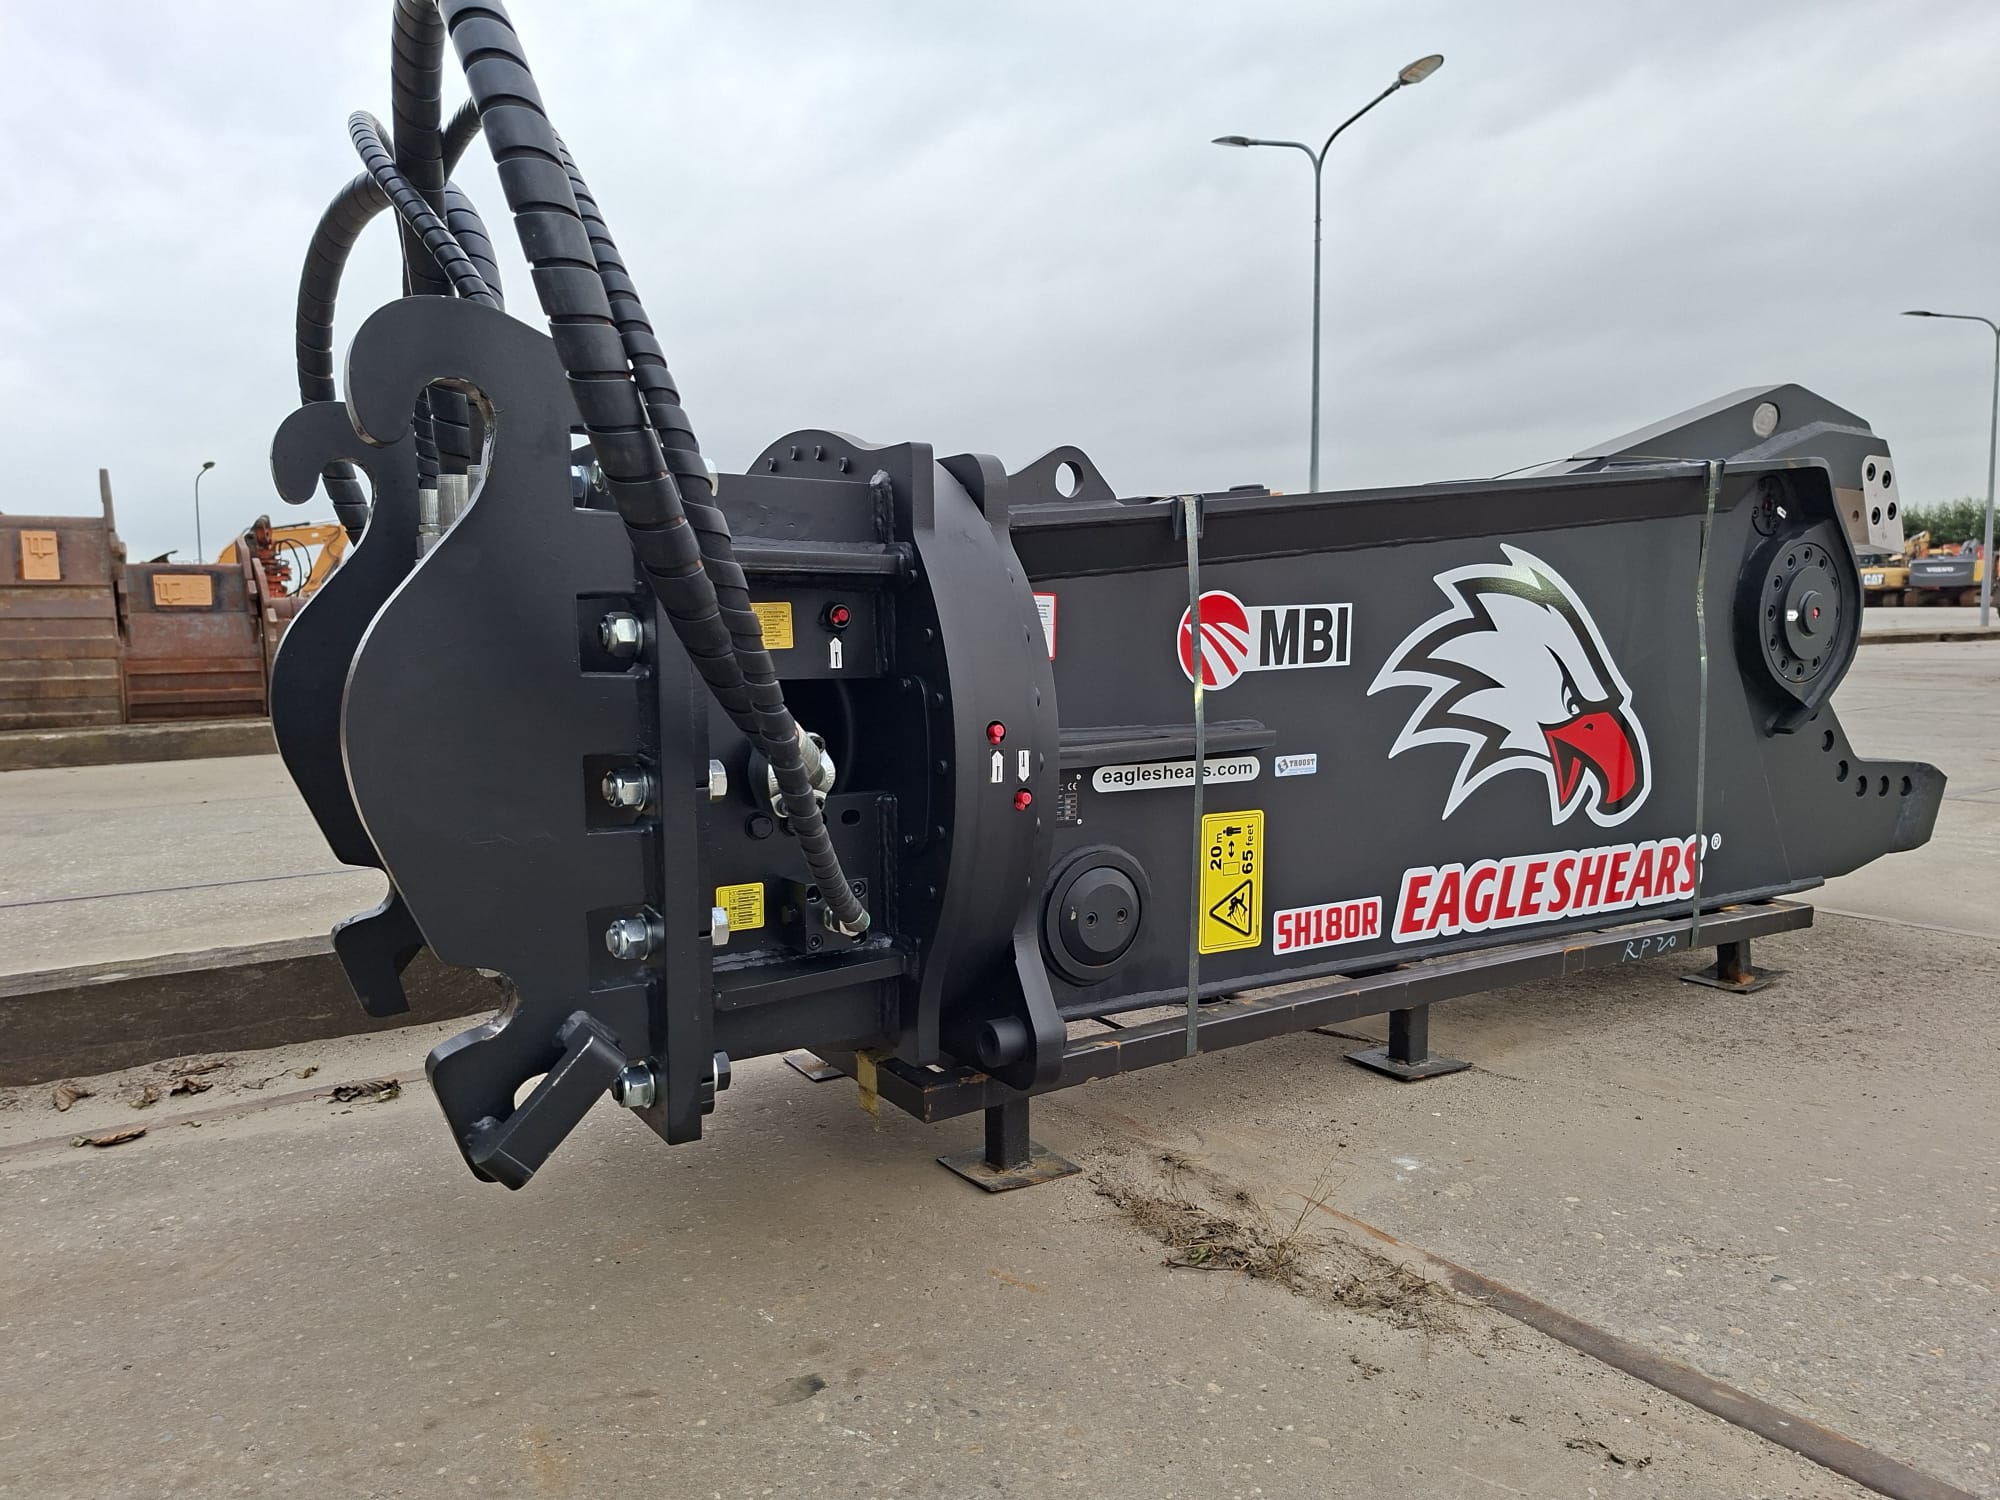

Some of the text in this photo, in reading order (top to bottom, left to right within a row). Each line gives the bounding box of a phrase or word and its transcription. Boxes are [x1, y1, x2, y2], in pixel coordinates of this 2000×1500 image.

[1863, 574, 1884, 585] CAT
[1259, 607, 1349, 667] MBI
[1102, 762, 1253, 786] eaglesheas.com
[1210, 832, 1223, 871] 20 m
[1242, 824, 1254, 874] 65 feet
[1399, 841, 1701, 935] EAGLESHEARS
[1278, 901, 1378, 950] SH180R
[1622, 938, 1651, 962] RP
